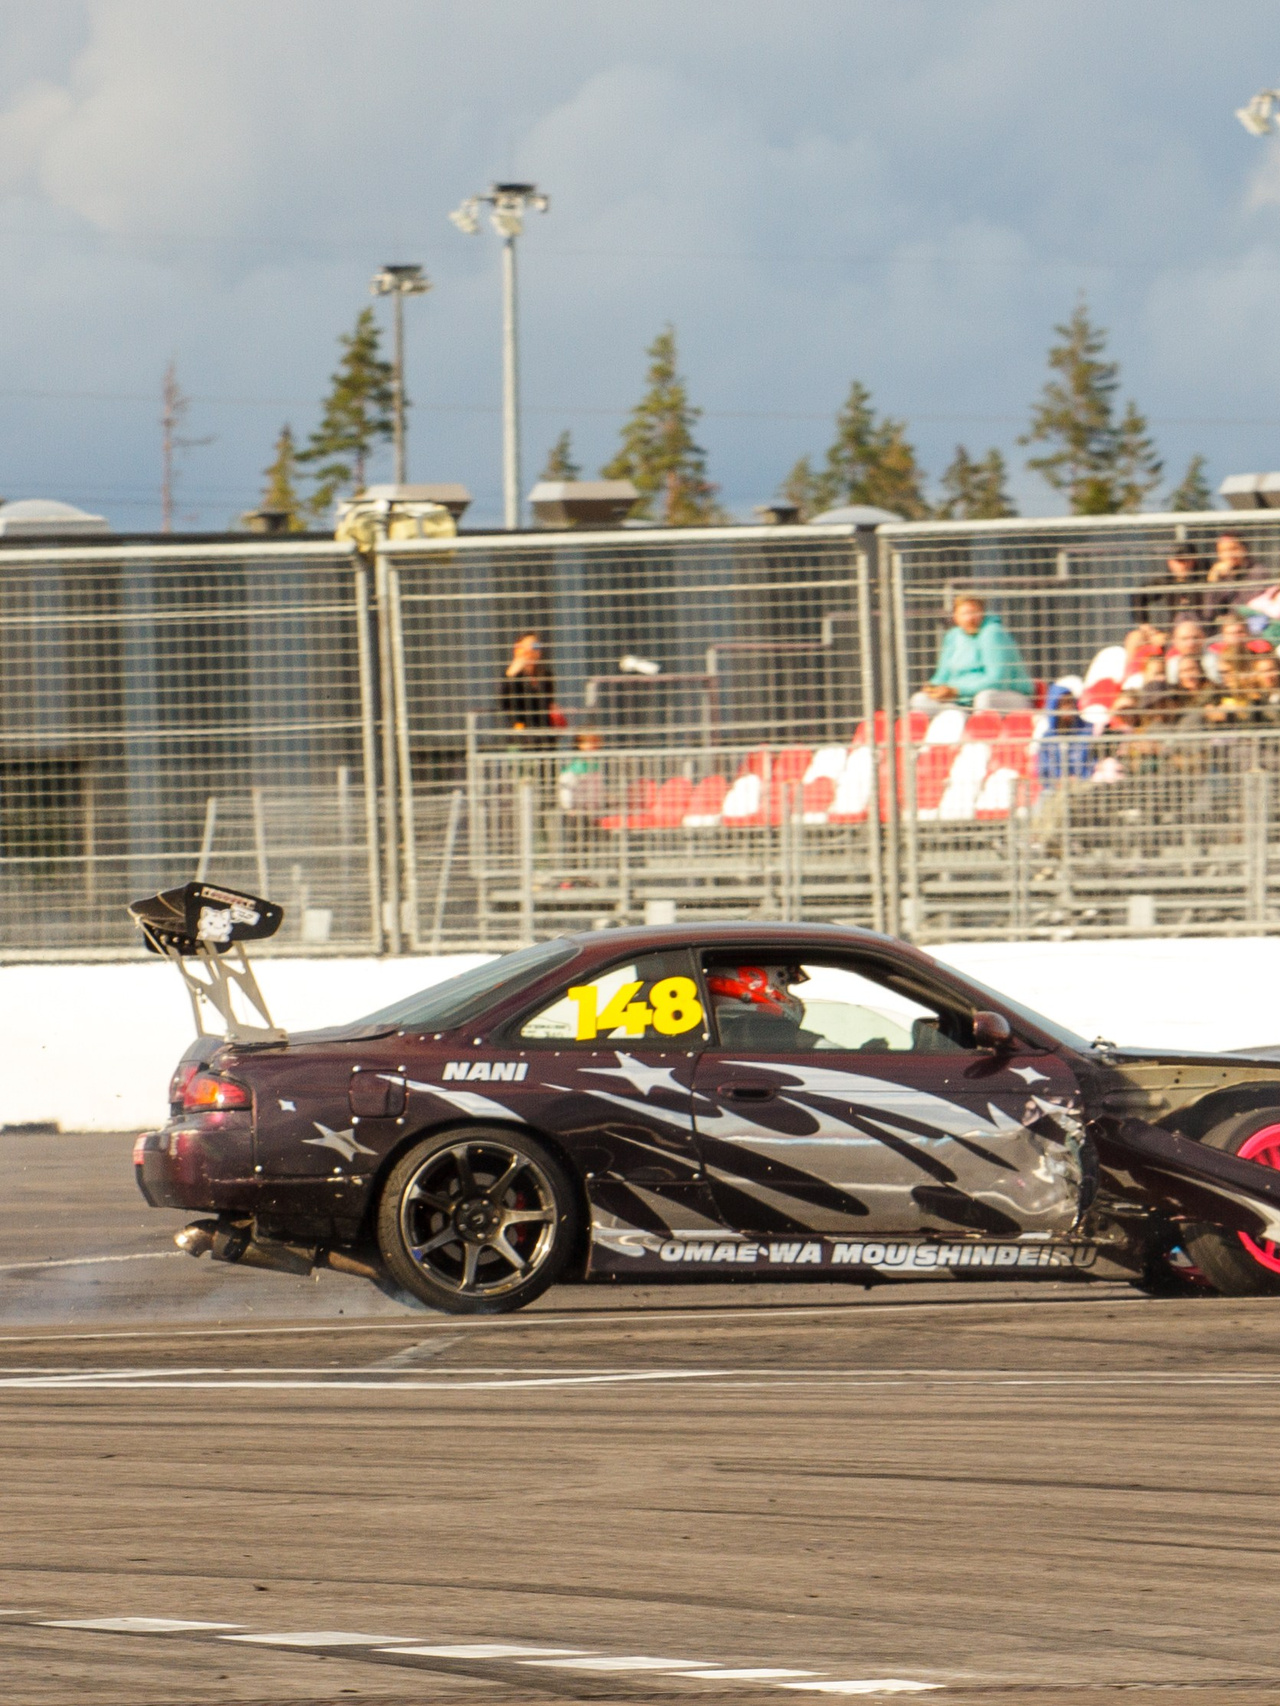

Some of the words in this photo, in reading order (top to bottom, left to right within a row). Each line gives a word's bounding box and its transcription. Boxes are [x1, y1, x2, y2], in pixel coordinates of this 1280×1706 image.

[568, 976, 703, 1041] 148
[442, 1061, 529, 1082] NANI
[660, 1240, 760, 1263] OMAE
[768, 1242, 822, 1264] WA
